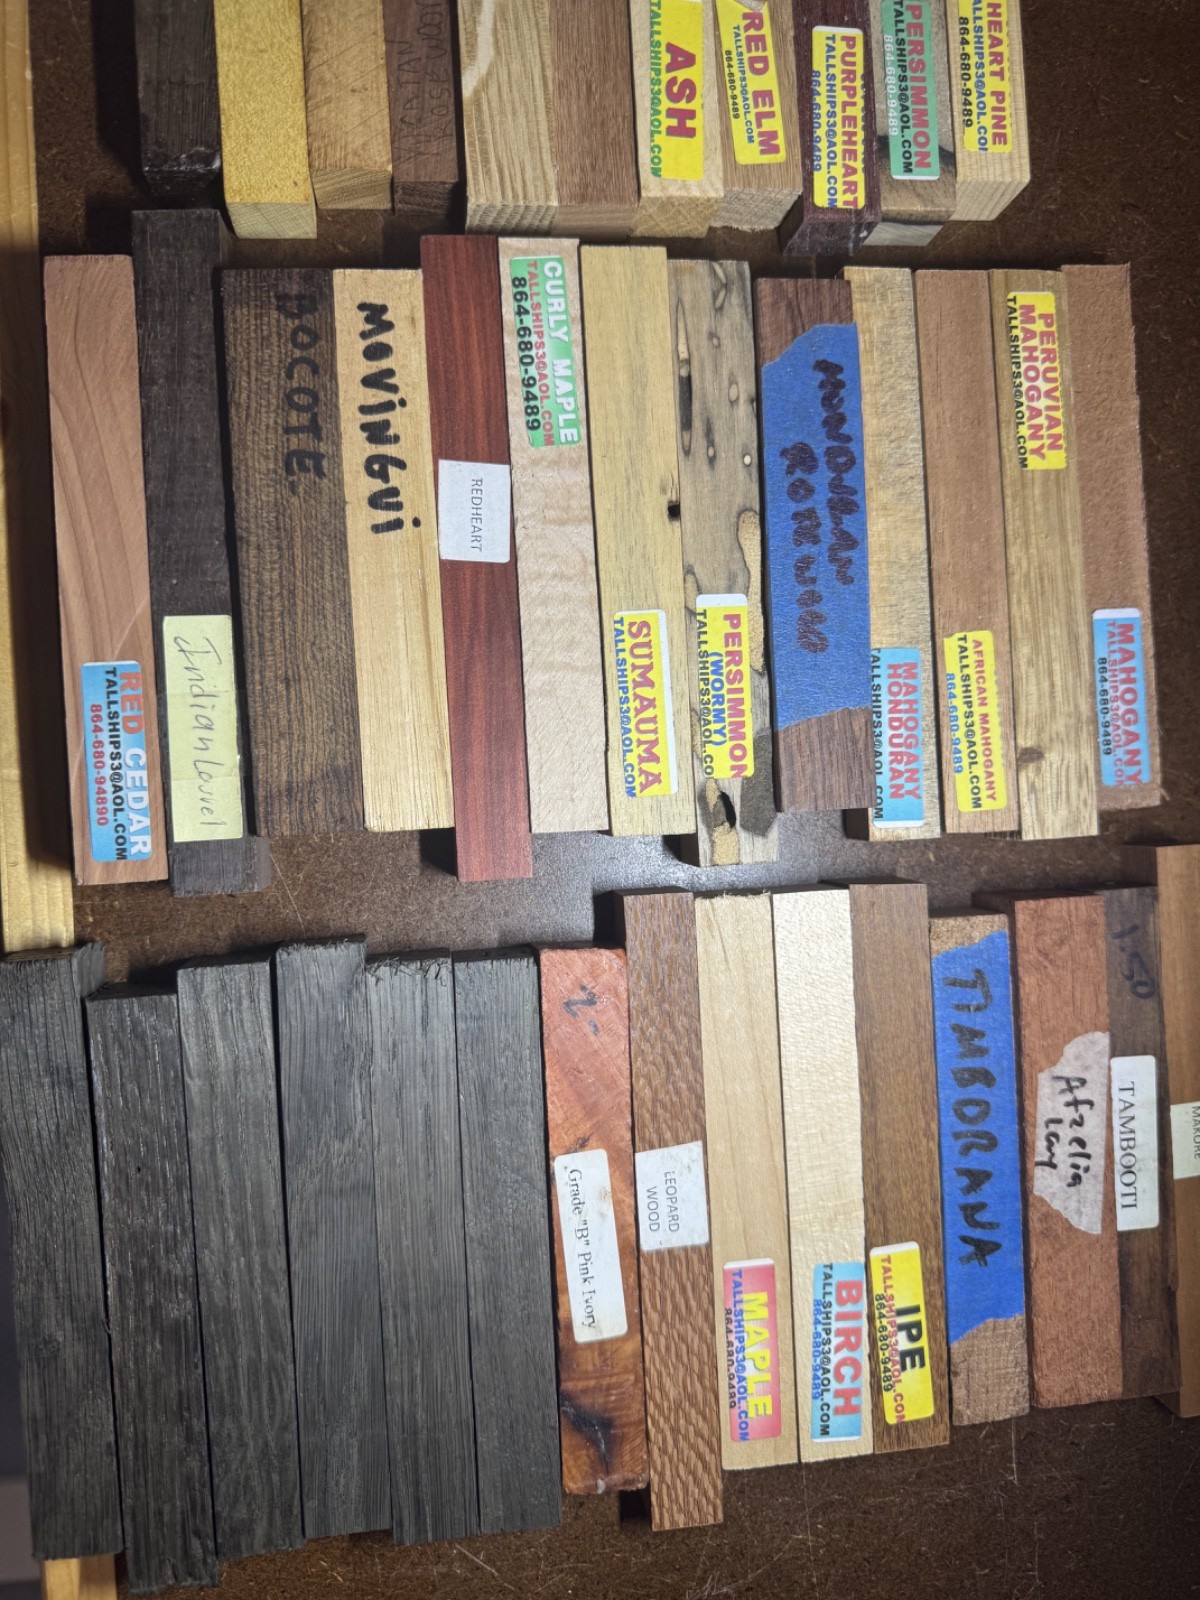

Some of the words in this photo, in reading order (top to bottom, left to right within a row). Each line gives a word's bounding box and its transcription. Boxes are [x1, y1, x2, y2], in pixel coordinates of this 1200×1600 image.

[665, 42, 697, 139] ASH
[725, 49, 740, 119] 864-680-9489
[732, 24, 754, 144] TALLSHIPS3@AOL.COM
[742, 11, 770, 76] RED
[883, 34, 898, 136] 864-680-9489
[893, 0, 913, 174] TALLSHIPS3@AOL.COM
[905, 4, 931, 169] PERSIMMON
[958, 16, 973, 128] 864-680-9489
[987, 2, 1004, 81] HEART
[752, 90, 781, 156] ELM
[840, 35, 859, 209] PURPLEHEART
[990, 91, 1007, 146] PINE
[512, 276, 540, 431] 864-680-9489
[527, 261, 555, 446] TALLSHIPS3@AOL.COM
[543, 261, 569, 342] CURLY
[551, 358, 578, 443] MAPLE
[1007, 295, 1028, 469] TALLSHIPS3@AOL.COM
[1019, 304, 1046, 461] MAHOGANY
[1038, 313, 1064, 451] PERUVIAN
[470, 478, 483, 552] REDHEART
[120, 672, 144, 734] RED
[173, 635, 223, 751] Indian
[628, 620, 663, 793] SUMAUMA
[695, 609, 714, 779] TALLSHIPS3@AOL.CO
[708, 651, 727, 746] (WORMY)
[723, 613, 748, 778] PERSIMMON
[945, 672, 963, 774] 864-680-9489
[957, 634, 982, 809] TALLSHIPS3@AOL.COM
[972, 639, 988, 707] AFRICAN
[1098, 657, 1112, 756] 864-680-9489
[1118, 623, 1143, 785] MAHOGANY
[90, 704, 109, 826] 864-680-94890
[105, 667, 127, 860] TALLSHIPS3@AOL.COM
[887, 663, 905, 799] HONDURAN
[902, 661, 921, 799] MAHOGANY
[978, 713, 996, 801] MAHOGANY
[125, 747, 152, 855] CEDAR
[942, 968, 1003, 1267] TIMBORANA
[1052, 1075, 1095, 1187] Afzelia
[1118, 1081, 1138, 1210] TAMBOOTI
[567, 1168, 587, 1215] Grade
[574, 1219, 590, 1246] "B"
[646, 1186, 659, 1232] WOOD
[664, 1171, 680, 1233] LEOPARD
[578, 1252, 596, 1284] Pink
[581, 1290, 597, 1329] Ivory
[743, 1292, 772, 1418] MAPLE
[820, 1263, 833, 1435] TALLSHIPS3@AOL.COM
[833, 1280, 863, 1416] BIRCH
[874, 1293, 893, 1392] 864-680-9489
[895, 1305, 926, 1372] IPE
